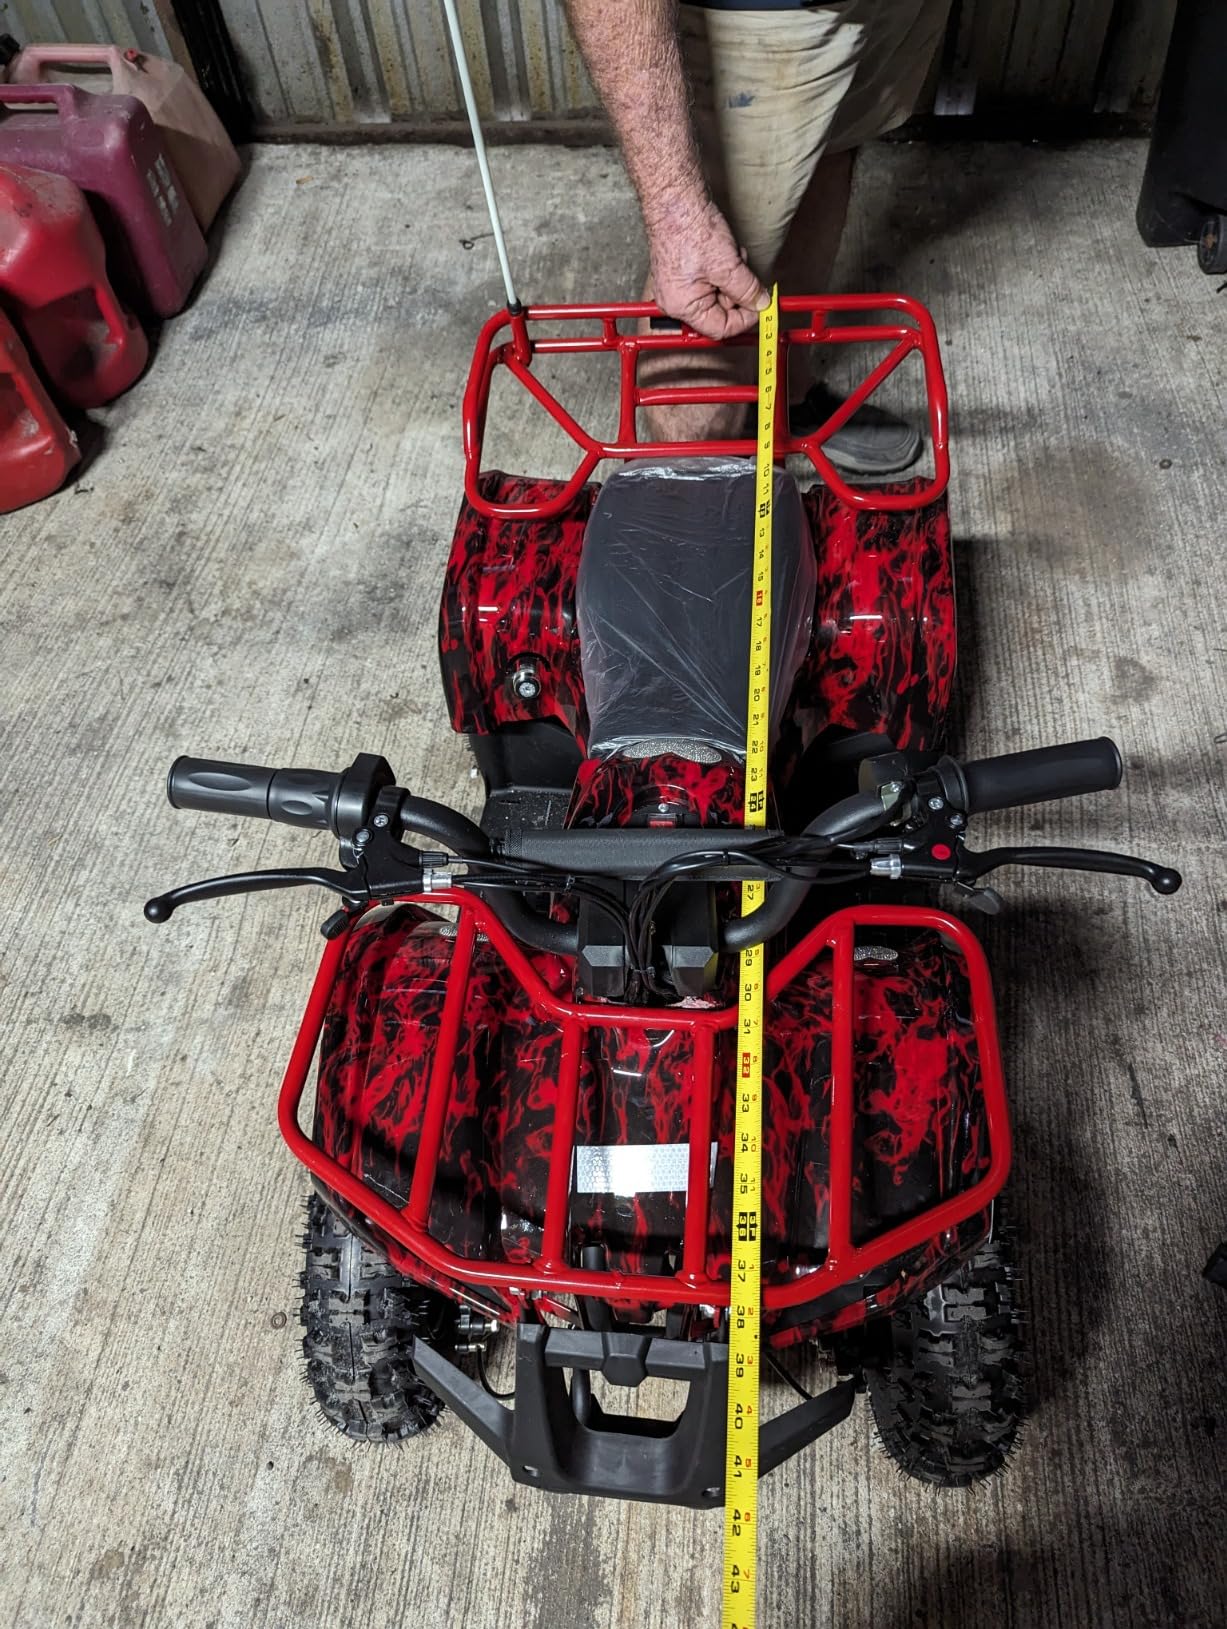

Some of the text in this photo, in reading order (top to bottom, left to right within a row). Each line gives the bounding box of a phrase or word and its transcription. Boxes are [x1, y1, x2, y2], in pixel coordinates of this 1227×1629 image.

[766, 315, 772, 323] 2
[763, 463, 770, 477] 10
[763, 483, 770, 495] 11
[759, 528, 765, 538] 13
[758, 549, 764, 559] 14
[758, 571, 764, 581] 15
[756, 616, 762, 627] 17
[755, 641, 762, 651] 18
[755, 665, 761, 676] 19
[753, 688, 760, 702] 20
[753, 713, 759, 726] 21
[752, 740, 758, 754] 22
[751, 768, 757, 782] 23
[747, 885, 754, 901] 27
[745, 950, 753, 967] 29
[744, 984, 752, 1001] 30
[744, 1019, 751, 1035] 31
[743, 1055, 750, 1075] 32
[742, 1093, 749, 1113] 33
[741, 1133, 748, 1153] 34
[751, 1136, 756, 1152] 10
[740, 1173, 748, 1194] 35
[750, 1178, 755, 1192] 11
[739, 1215, 747, 1238] 36
[749, 1215, 756, 1238] 3F
[738, 1260, 746, 1282] 37
[736, 1305, 744, 1329] 38
[748, 1307, 754, 1316] 2
[736, 1353, 744, 1378] 39
[747, 1356, 753, 1365] 3
[746, 1405, 753, 1414] 4
[735, 1403, 743, 1431] 40
[734, 1455, 742, 1478] 41
[745, 1458, 752, 1468] 5
[732, 1509, 741, 1537] 42
[744, 1512, 751, 1522] 6
[731, 1565, 740, 1593] 43
[744, 1569, 750, 1579] 7
